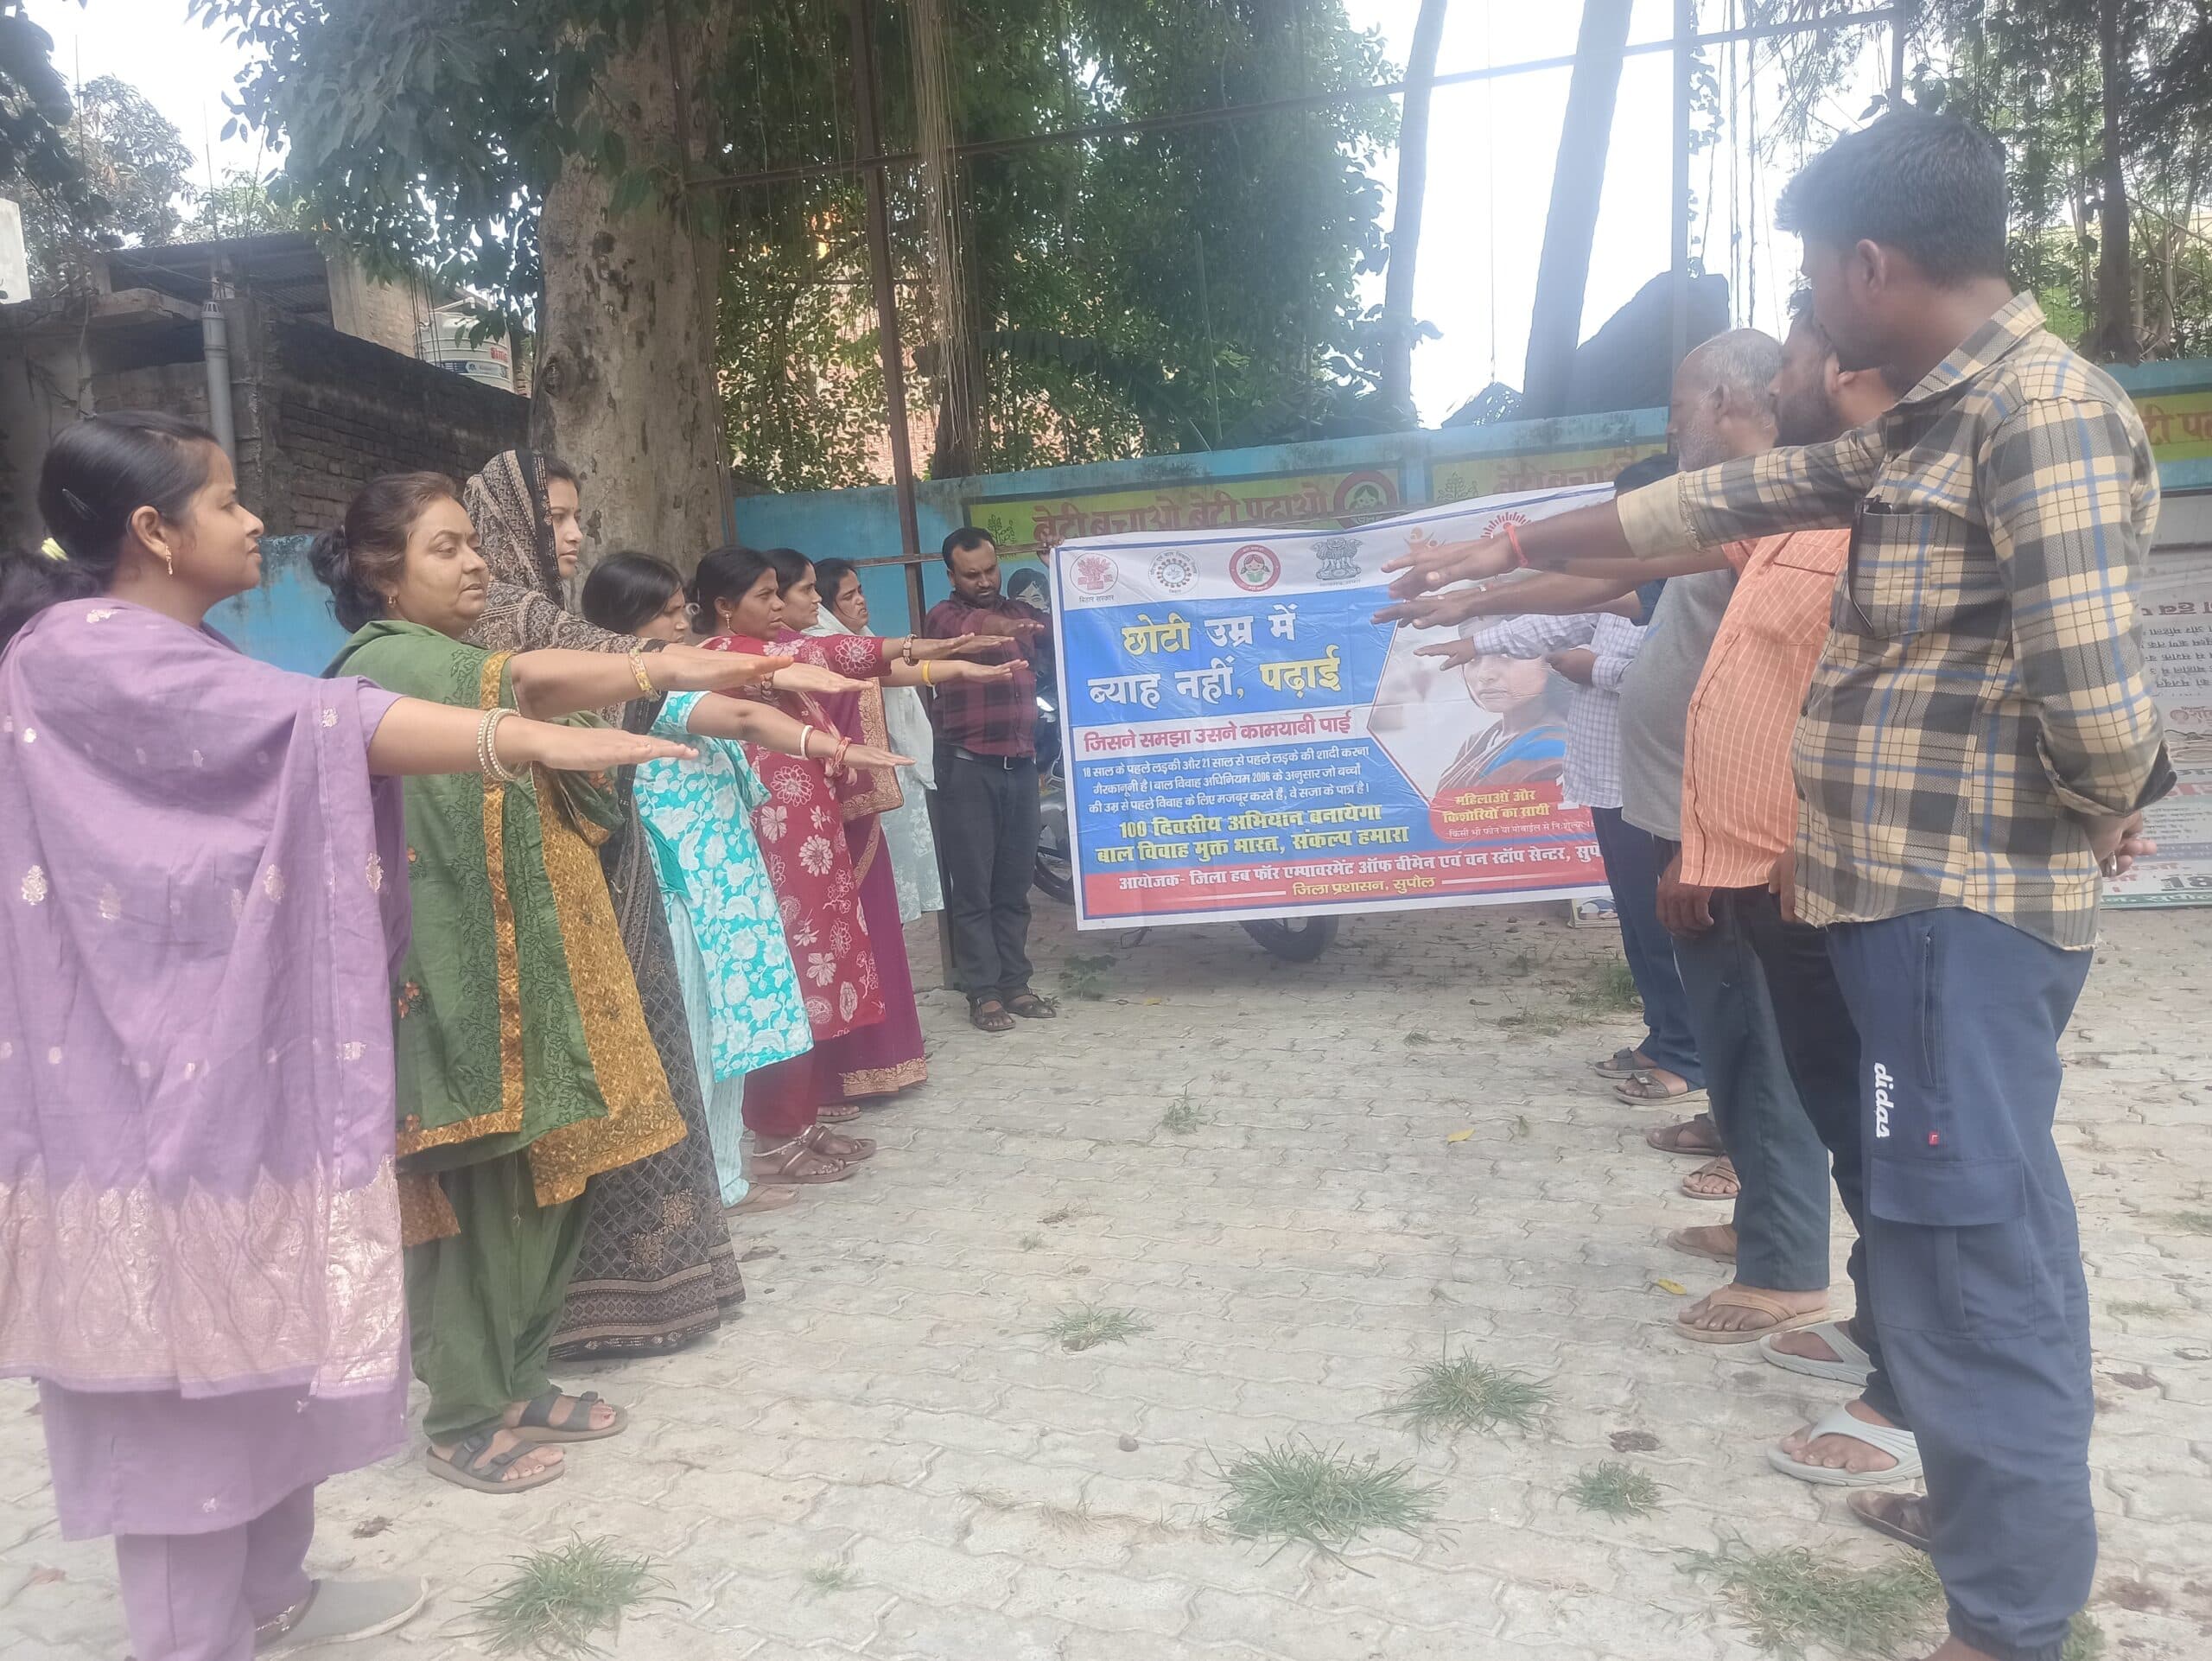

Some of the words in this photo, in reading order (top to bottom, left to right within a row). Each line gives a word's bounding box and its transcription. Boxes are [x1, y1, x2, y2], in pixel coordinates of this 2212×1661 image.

[1033, 501, 1088, 540] बेटी
[1090, 495, 1182, 533] बचाओ
[1189, 490, 1240, 526] बेटी
[1122, 612, 1192, 656] छोटी
[1204, 615, 1254, 647] उम्र
[1268, 603, 1298, 641] में
[1087, 673, 1161, 709] ब्याह
[1174, 655, 1244, 703] नहीं,
[1259, 645, 1342, 699] पढ़ाई
[1084, 729, 1136, 752] जिसने
[1139, 729, 1192, 748] समझा
[1194, 720, 1237, 743] उसने
[1240, 713, 1316, 739] कामयाबी
[1319, 710, 1352, 734] पाई
[1092, 767, 1114, 778] साल
[1115, 762, 1125, 775] के
[1127, 760, 1151, 775] पहले
[1152, 757, 1180, 774] लड़की
[1182, 756, 1201, 770] और
[1201, 759, 1210, 768] 21
[1211, 755, 1233, 768] साल
[1235, 753, 1245, 766] से
[1246, 751, 1271, 766] पहले
[1300, 745, 1314, 761] की
[1316, 745, 1339, 760] शादी
[1340, 746, 1370, 757] करना
[1154, 780, 1173, 791] बाल
[1175, 775, 1202, 790] विवाह
[1203, 772, 1250, 787] अधिनियम
[1251, 770, 1271, 783] 2006
[1272, 769, 1283, 781] के
[1285, 768, 1320, 785] अनुसार
[1321, 765, 1336, 778] जो
[1088, 800, 1103, 813] की
[1119, 799, 1128, 811] से
[1130, 797, 1155, 811] पहले
[1155, 795, 1183, 808] विवाह
[1185, 793, 1195, 805] के
[1197, 792, 1216, 805] लिए
[1217, 792, 1249, 807] मजबूर
[1249, 788, 1274, 802] करते
[1289, 786, 1297, 799] वे
[1299, 786, 1321, 799] सजा
[1323, 783, 1334, 796] के
[1454, 789, 1511, 806] महिलाओं
[1513, 787, 1536, 803] और
[1119, 820, 1147, 838] 100
[1151, 814, 1223, 837] दिवसीय
[1228, 810, 1304, 832] अभियान
[1307, 803, 1382, 824] बनायेगा
[1442, 805, 1499, 823] किशोरियों
[1501, 806, 1519, 819] का
[1095, 845, 1135, 863] बाल
[1137, 841, 1189, 861] विवाह
[1192, 839, 1230, 862] मुक्त
[1234, 836, 1286, 855] भारत,
[1291, 828, 1353, 850] संकल्प
[1356, 825, 1409, 845] हमारा
[1449, 828, 1469, 838] किसी
[1483, 825, 1499, 837] फोन
[1189, 869, 1227, 886] जिला
[1229, 869, 1252, 881] हब
[1253, 864, 1280, 881] फॉर
[1358, 856, 1393, 874] ऑफ
[1438, 851, 1461, 869] एवं
[1464, 852, 1489, 866] वन
[1491, 848, 1526, 864] स्टॉप
[1293, 881, 1331, 896] जिला
[1393, 874, 1437, 894] सुपौल
